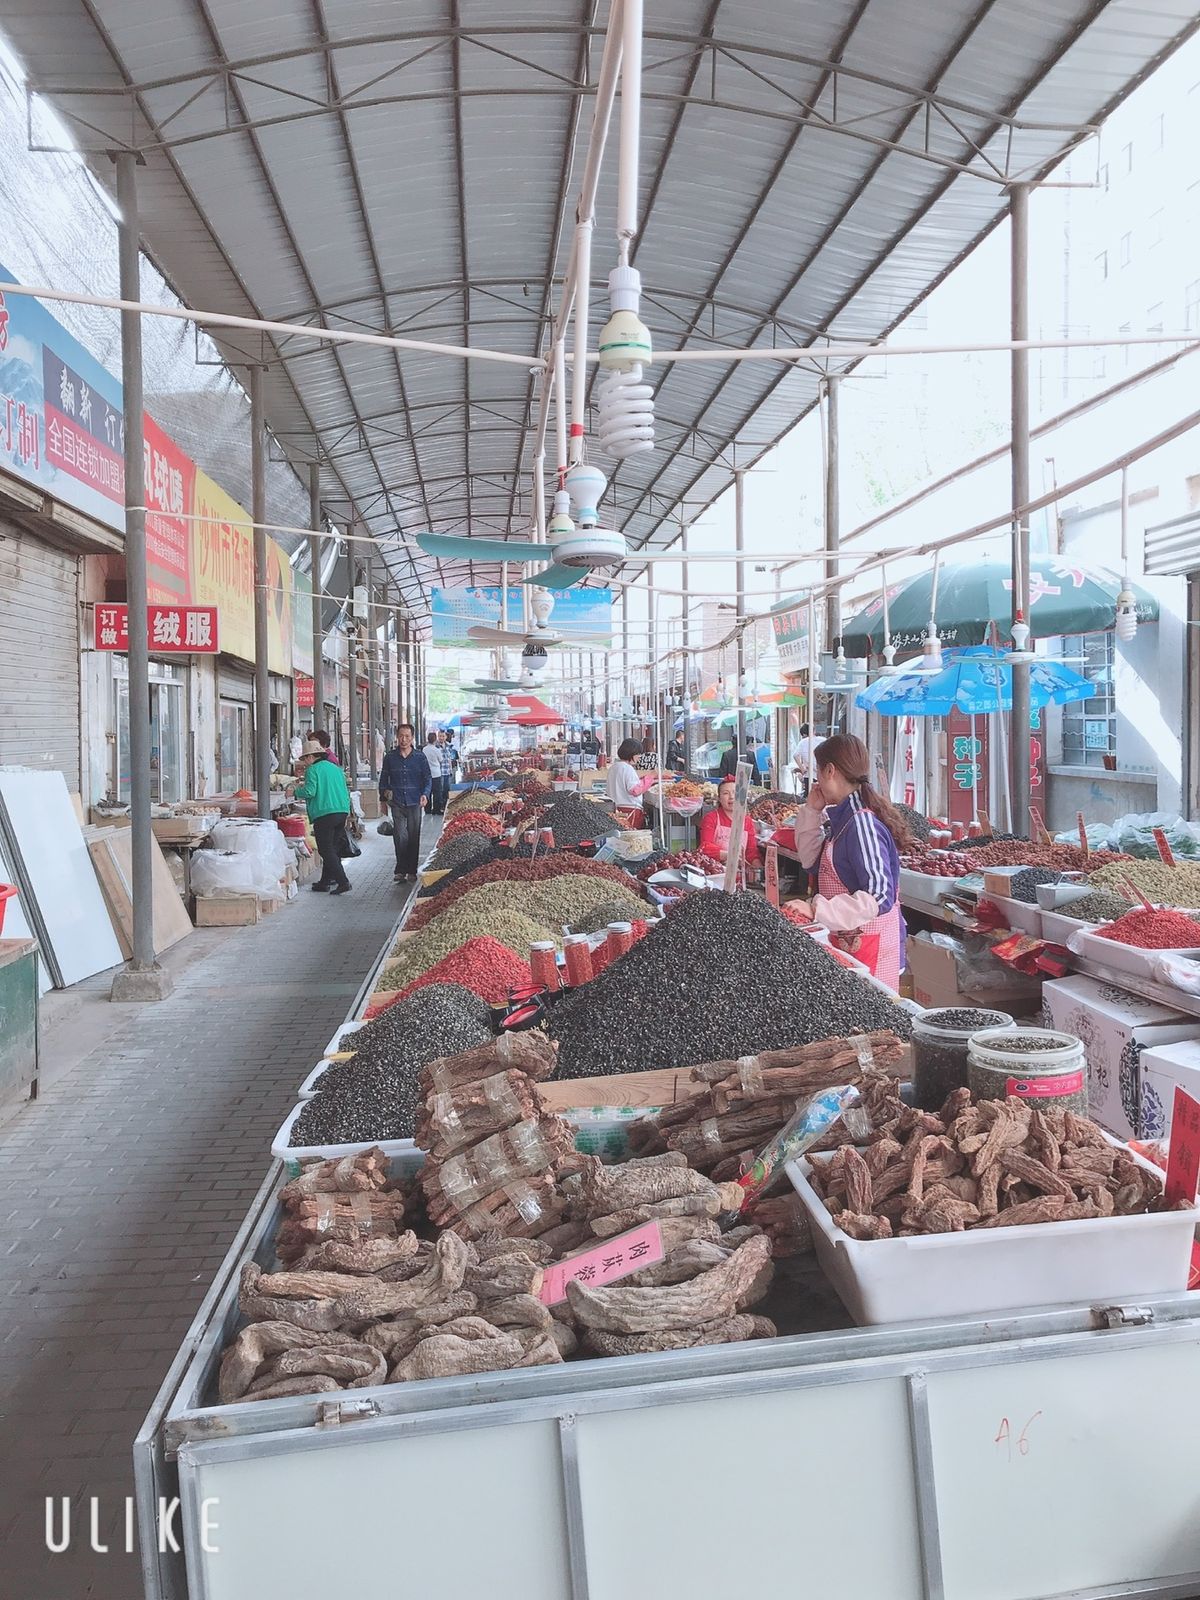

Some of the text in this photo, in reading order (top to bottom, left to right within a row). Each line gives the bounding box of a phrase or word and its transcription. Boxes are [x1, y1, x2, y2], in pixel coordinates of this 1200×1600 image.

[892, 629, 958, 649] 农夫山泉点甜
[994, 1410, 1043, 1463] A6
